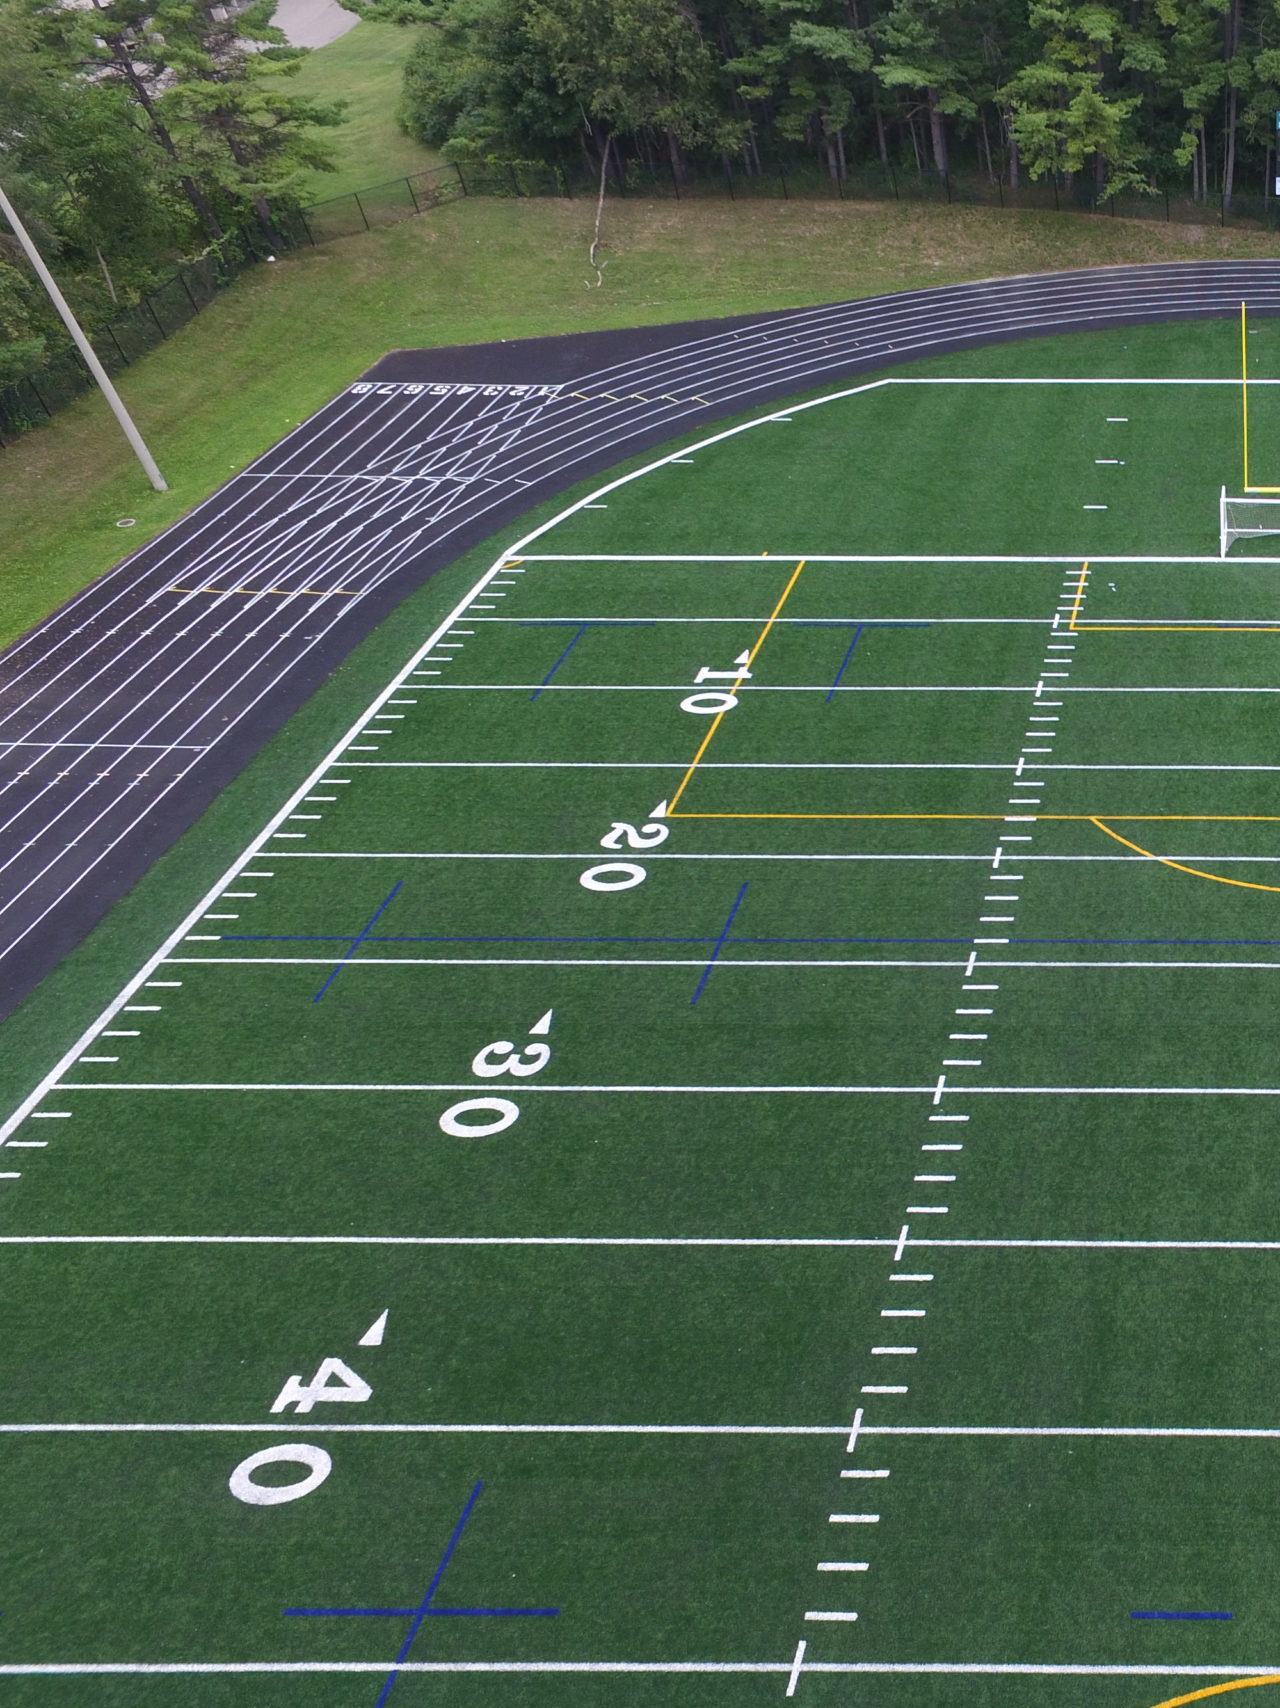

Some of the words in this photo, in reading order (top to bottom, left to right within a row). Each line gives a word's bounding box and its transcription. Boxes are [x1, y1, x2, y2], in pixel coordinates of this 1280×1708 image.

[351, 384, 373, 394] 8
[376, 384, 397, 394] 7
[429, 385, 451, 395] 5
[456, 386, 476, 395] 4
[482, 386, 503, 395] 3
[509, 386, 530, 396] 2
[680, 664, 752, 714] 10
[580, 823, 669, 891] 20
[439, 1041, 550, 1137] 30
[229, 1358, 373, 1505] 40
